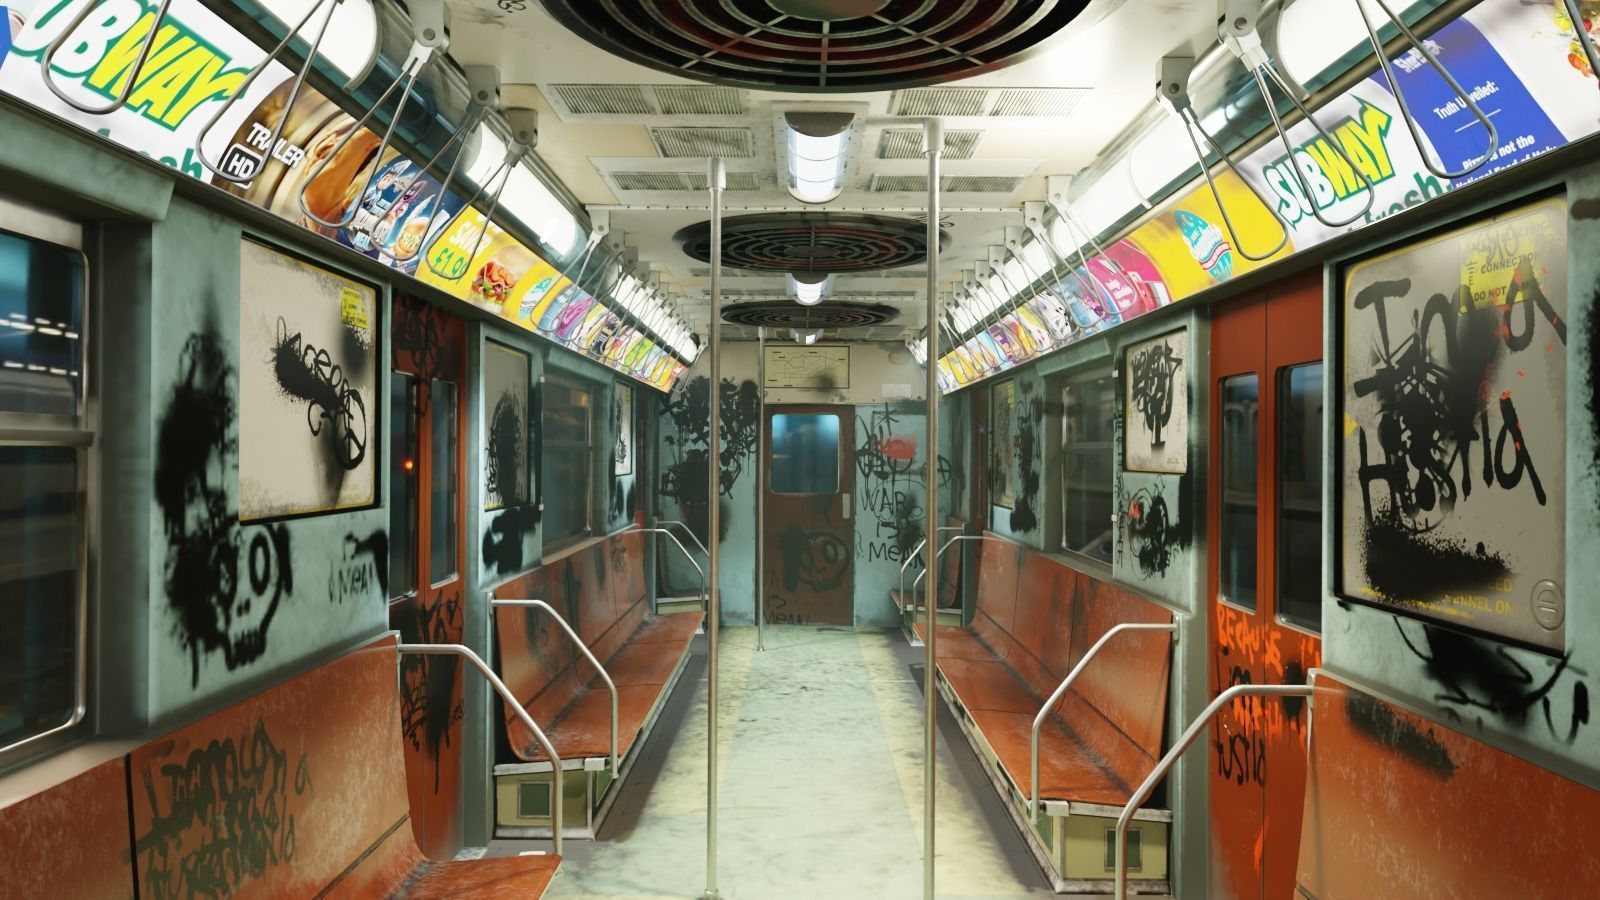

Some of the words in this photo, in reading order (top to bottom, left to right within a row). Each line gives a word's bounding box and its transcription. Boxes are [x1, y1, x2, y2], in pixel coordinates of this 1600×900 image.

[8, 0, 254, 132] UBWAY
[1433, 98, 1460, 120] Truth
[1456, 80, 1500, 109] Uveiled:
[246, 121, 305, 169] TRAILER
[1262, 93, 1396, 232] SUBWAY
[1498, 141, 1517, 158] not
[1516, 134, 1536, 150] the
[227, 152, 255, 179] HD
[1473, 290, 1486, 302] DO
[1490, 286, 1507, 300] NOT
